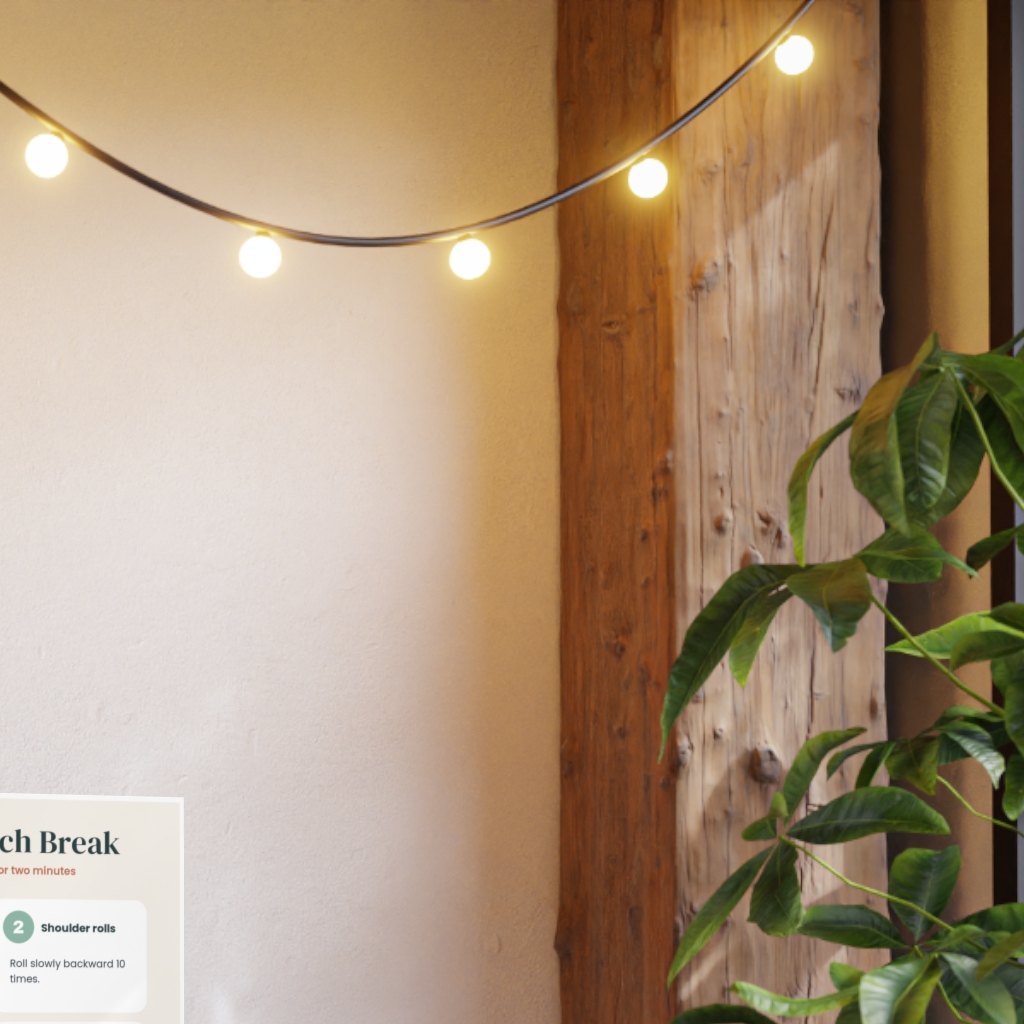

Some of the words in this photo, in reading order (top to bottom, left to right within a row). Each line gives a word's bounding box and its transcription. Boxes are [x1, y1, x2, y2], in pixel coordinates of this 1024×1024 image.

[40, 830, 120, 855] Break
[10, 865, 31, 875] two
[32, 865, 77, 876] minutes
[13, 920, 24, 934] 2
[40, 922, 91, 933] Shoulder
[92, 923, 116, 933] rolls
[9, 958, 28, 968] Roll
[30, 958, 62, 971] slowly
[63, 959, 114, 969] backward
[116, 959, 126, 969] 10
[9, 974, 40, 984] times.
